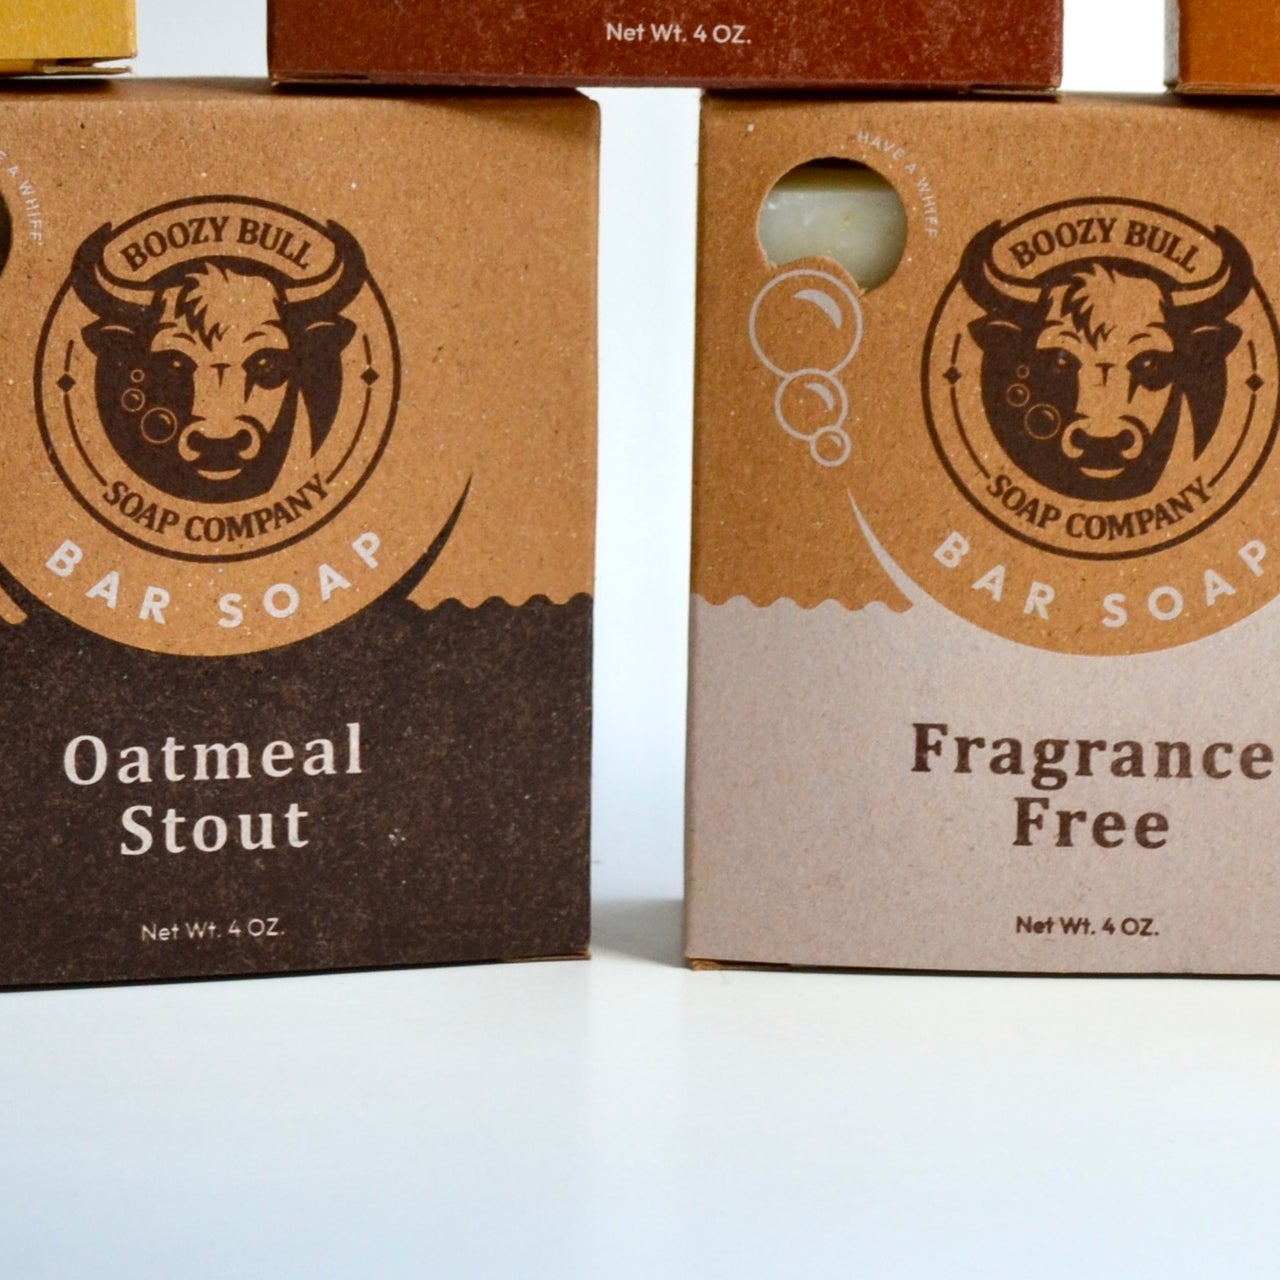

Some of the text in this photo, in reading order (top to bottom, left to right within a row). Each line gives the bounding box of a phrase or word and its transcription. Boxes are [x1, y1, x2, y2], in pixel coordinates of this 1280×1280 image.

[606, 22, 751, 44] Net Wt. 4 OZ.
[8, 165, 19, 178] A
[19, 180, 43, 242] WHIFF
[857, 131, 939, 238] HAVE A WHIFF
[118, 215, 312, 273] BOOZY BULL
[1007, 217, 1199, 273] BOOZY BULL
[102, 473, 329, 542] SOAP COMPANY
[986, 473, 1211, 541] SOAP COMPANY
[45, 531, 381, 629] BAR SOAP
[932, 530, 1268, 628] BAR SOAP
[63, 722, 362, 786] Oatmeal
[910, 722, 1274, 791] Fragrance
[120, 803, 309, 856] Stout
[1012, 796, 1170, 849] Free
[141, 918, 285, 941] Net Wt. 4 OZ.
[1016, 916, 1159, 936] Net Wt. 4 OZ.
